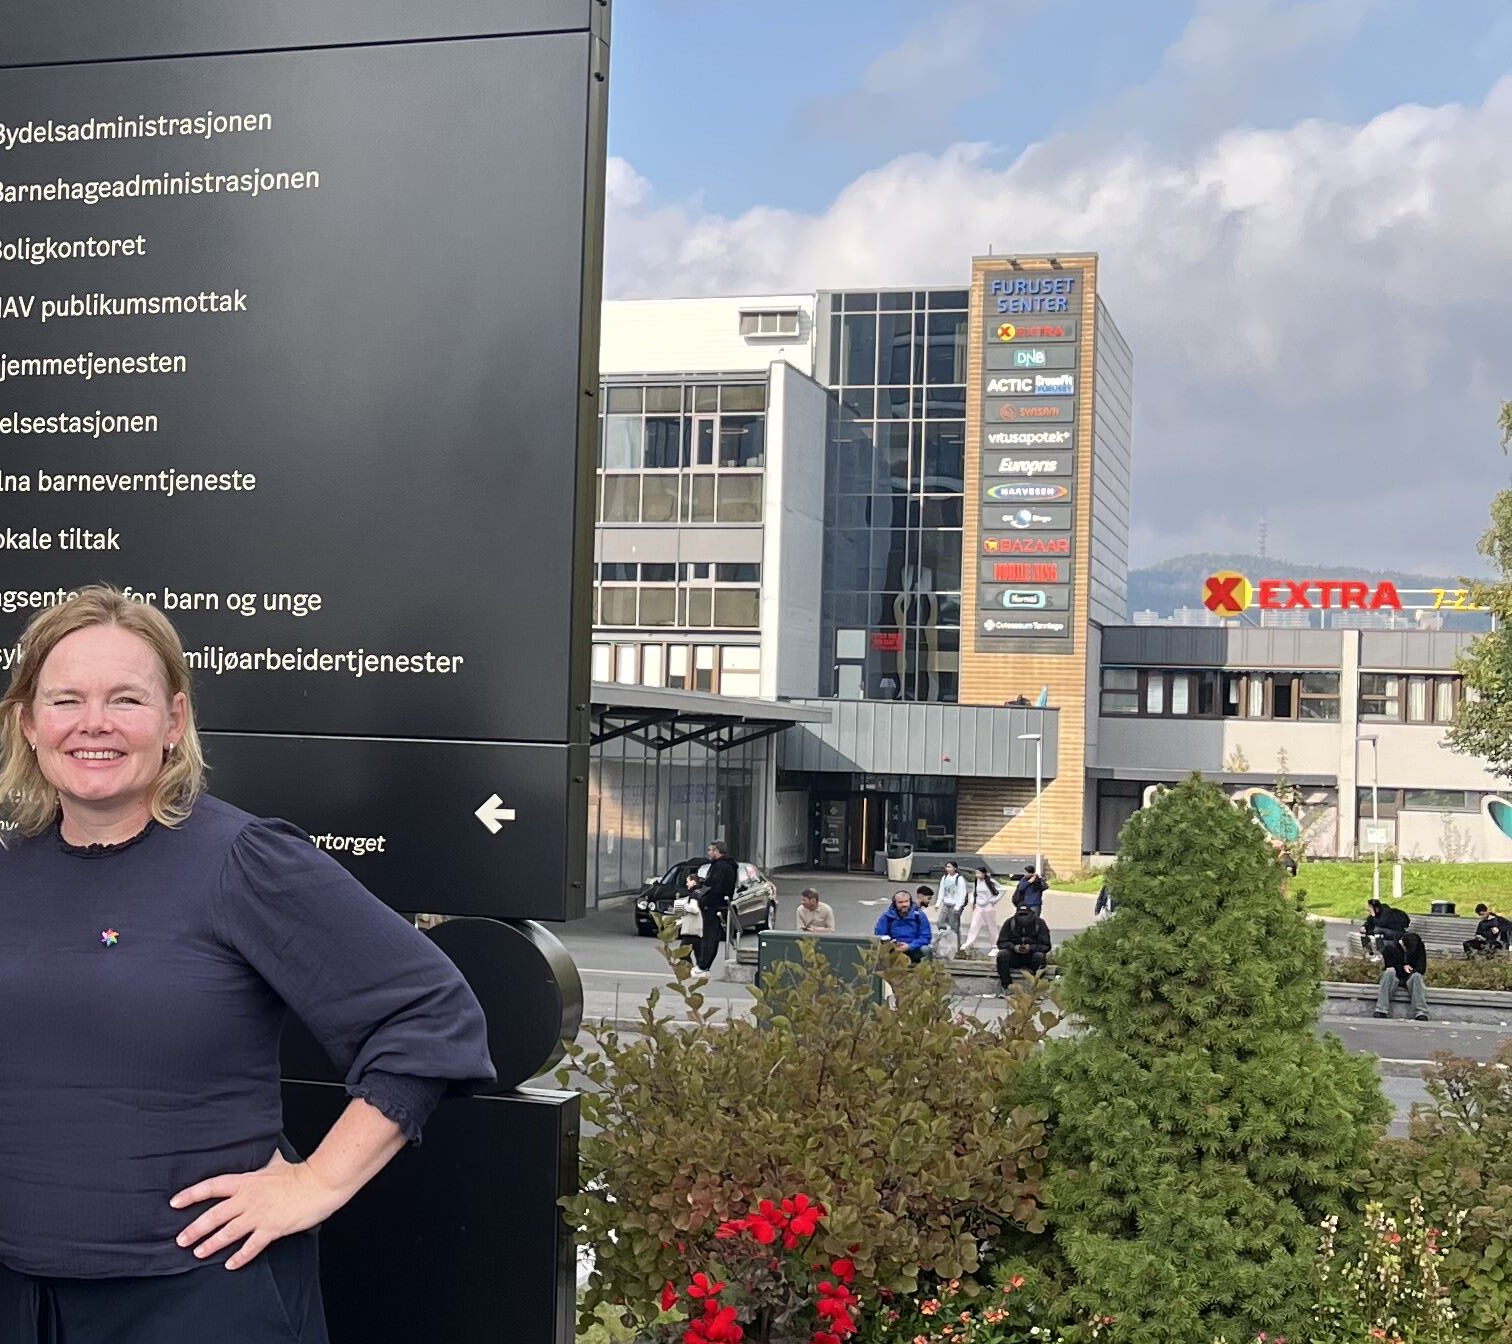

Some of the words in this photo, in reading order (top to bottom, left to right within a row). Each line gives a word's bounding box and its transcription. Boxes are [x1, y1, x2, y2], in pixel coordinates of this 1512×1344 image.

[991, 277, 1074, 296] FURUSET
[41, 288, 248, 323] publikumsmottak
[997, 296, 1067, 313] SENTER
[1017, 348, 1045, 367] DNB
[987, 378, 1033, 393] ACTIC
[38, 468, 256, 497] barneverntjeneste
[57, 527, 121, 551] tiltak
[999, 538, 1069, 552] BAZAAR
[163, 587, 219, 610] barn
[226, 593, 257, 617] og
[263, 593, 322, 617] unge
[1258, 579, 1402, 610] EXTRA
[183, 645, 464, 678] miljøarbeidertjenester
